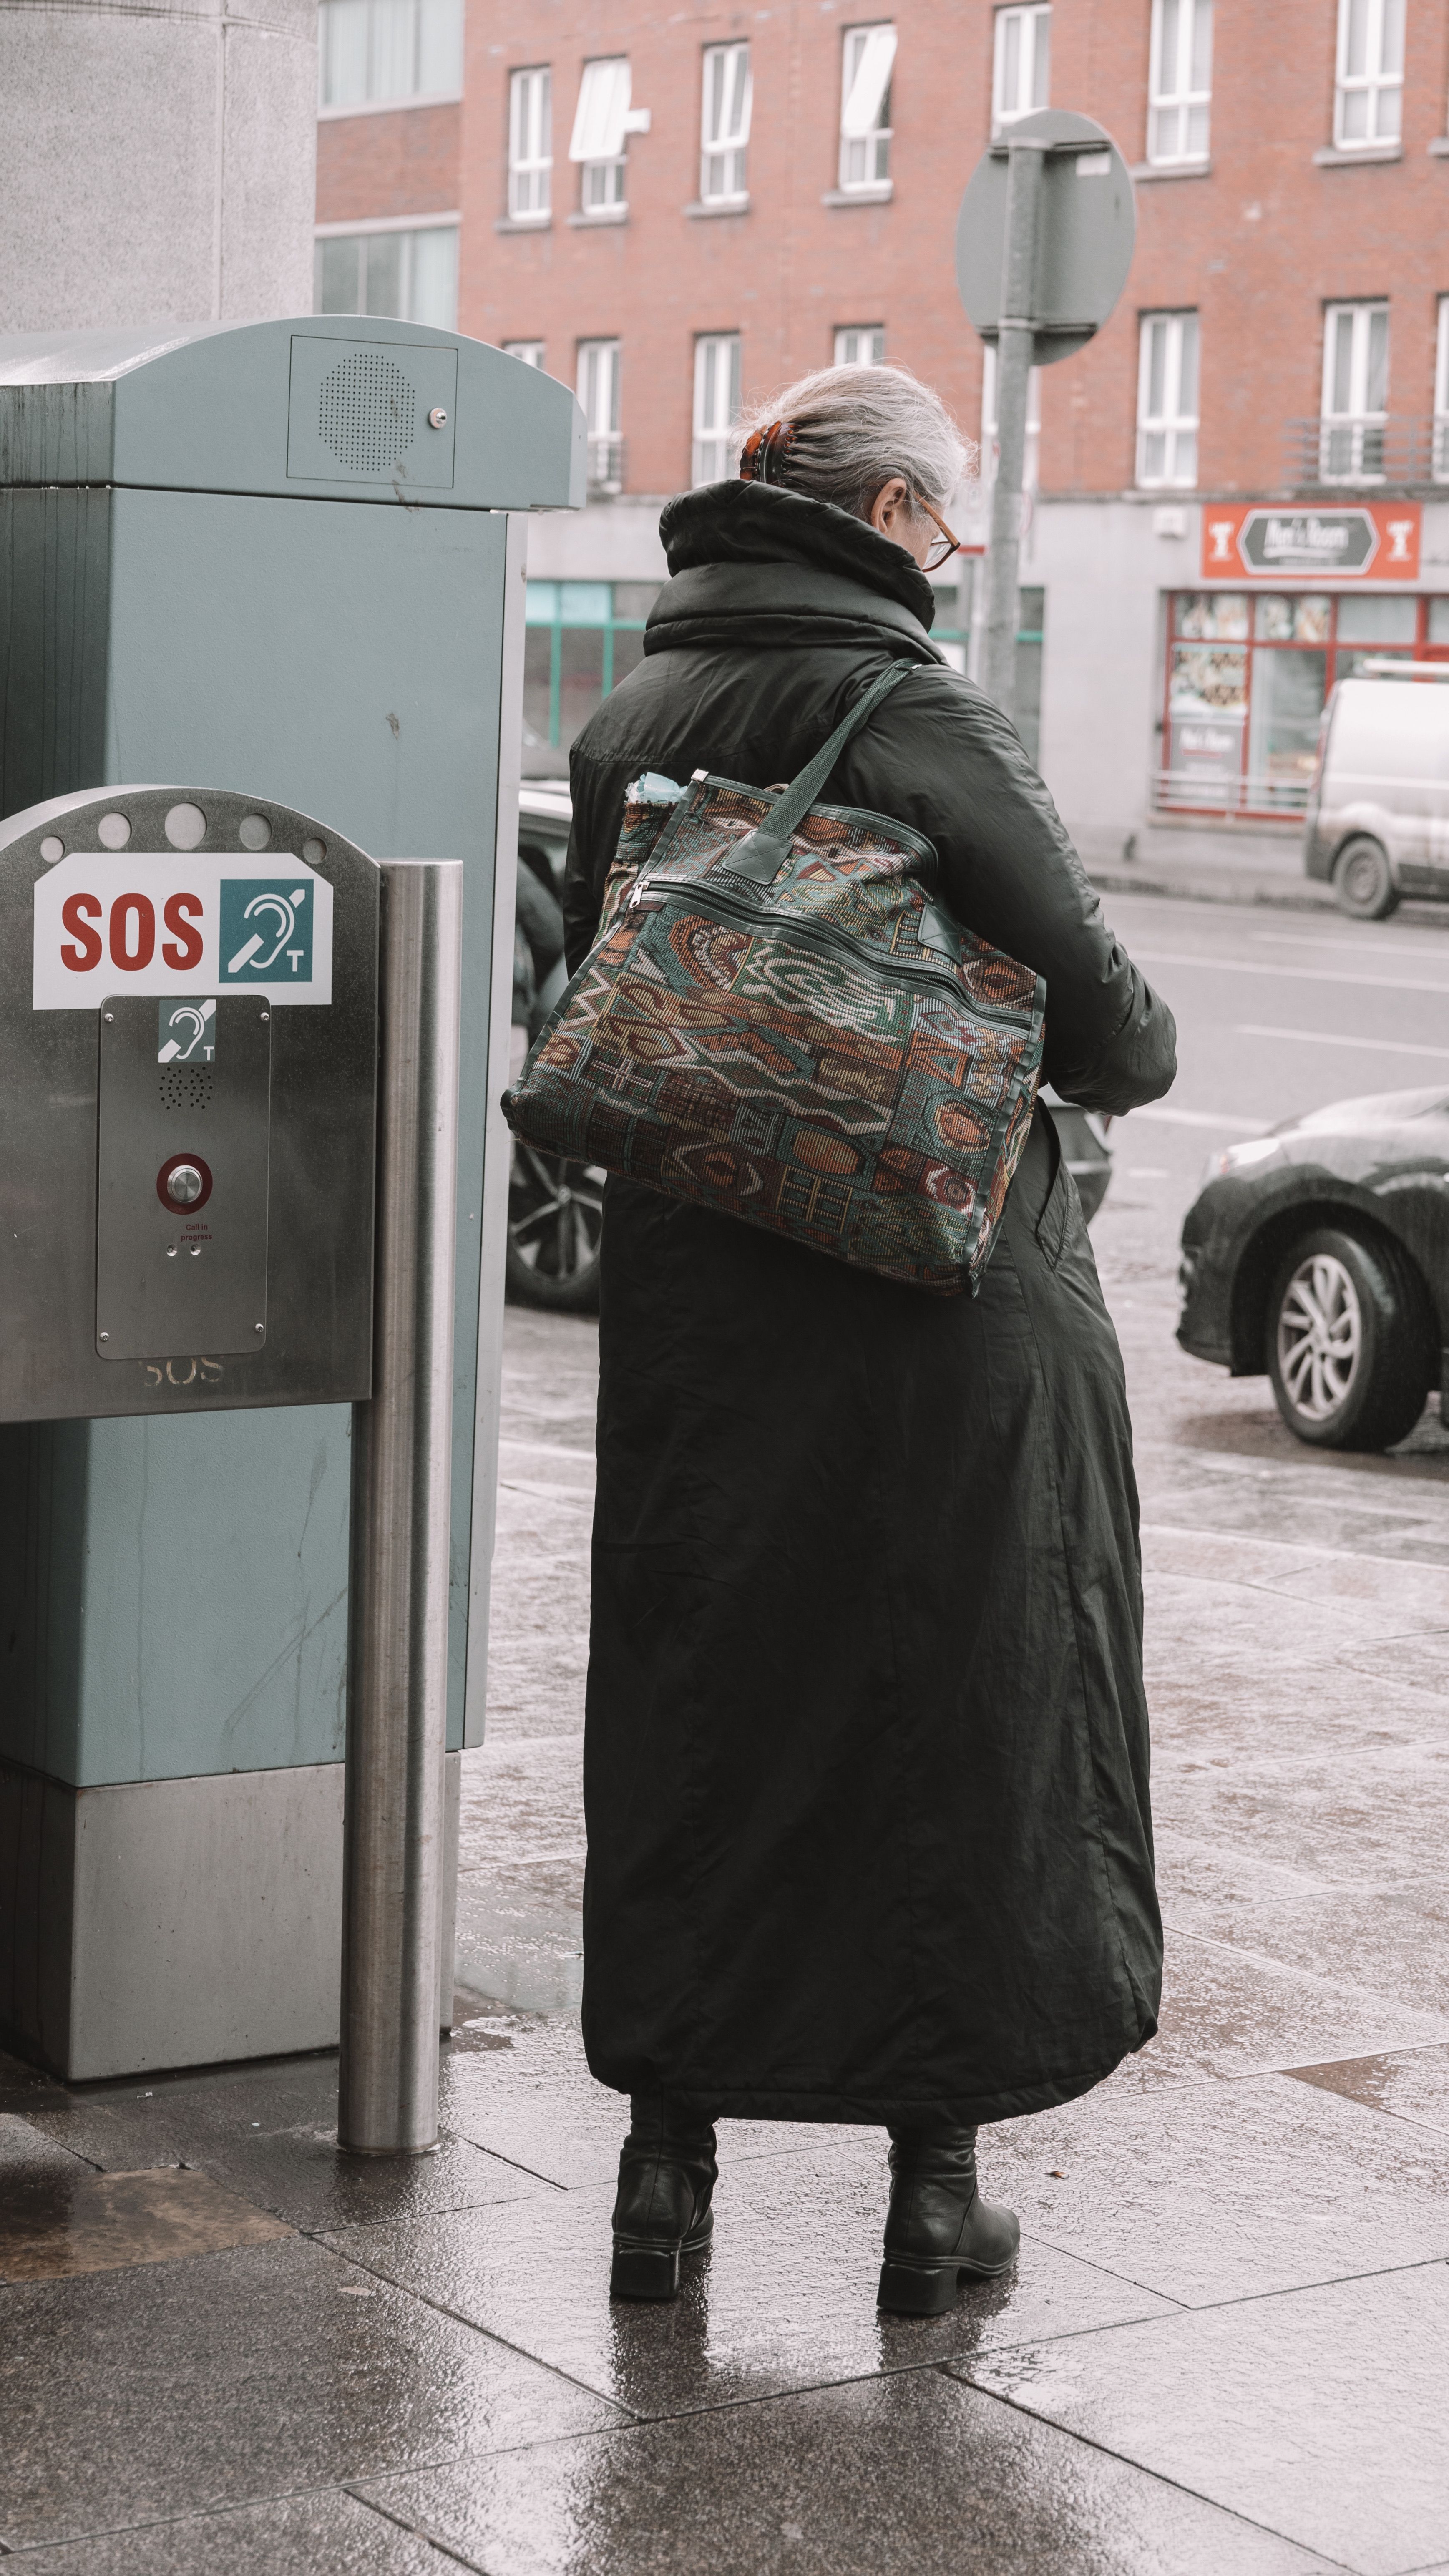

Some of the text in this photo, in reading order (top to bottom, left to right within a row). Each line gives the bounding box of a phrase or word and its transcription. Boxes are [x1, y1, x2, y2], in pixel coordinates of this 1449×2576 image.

[60, 893, 204, 972] SOS
[287, 950, 304, 972] T
[204, 1046, 214, 1061] T
[181, 1234, 213, 1242] progress
